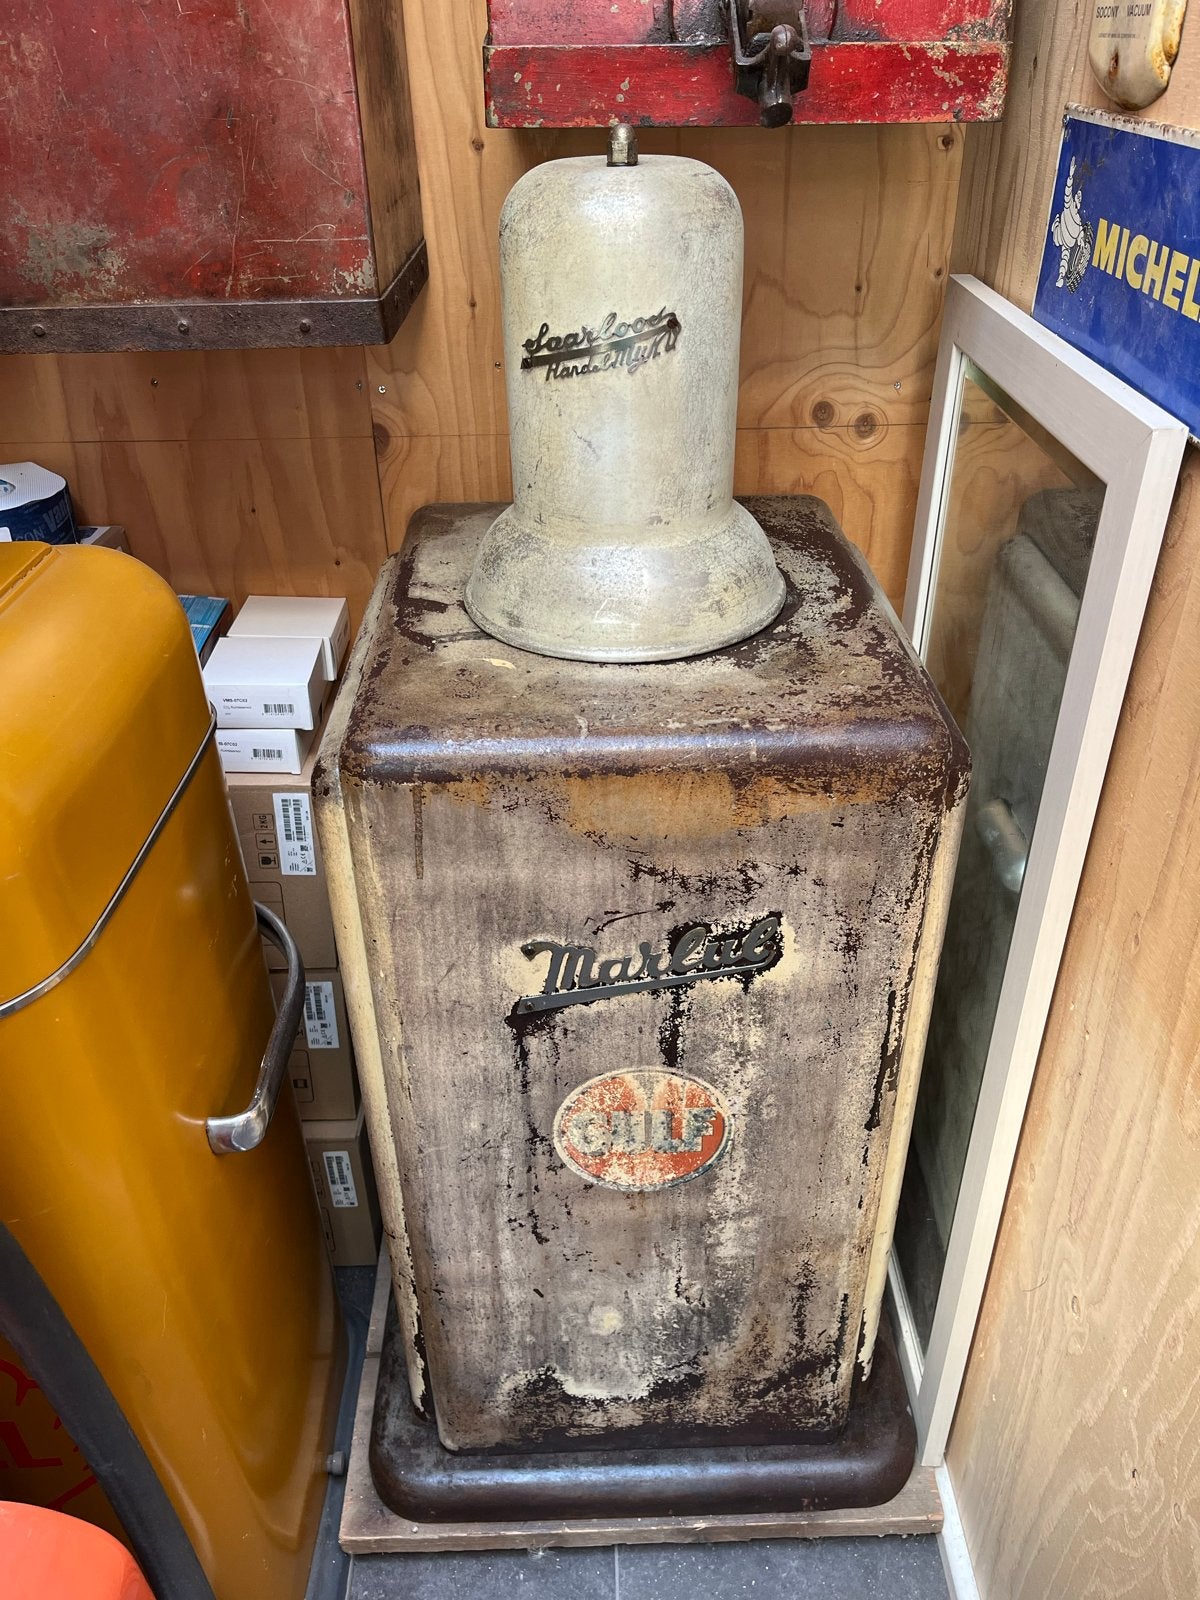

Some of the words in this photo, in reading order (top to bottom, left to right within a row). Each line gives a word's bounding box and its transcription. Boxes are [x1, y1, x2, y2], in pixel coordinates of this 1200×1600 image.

[1096, 6, 1119, 18] SOCONY
[1127, 3, 1152, 17] VACUUM
[1091, 217, 1200, 322] MICHEL
